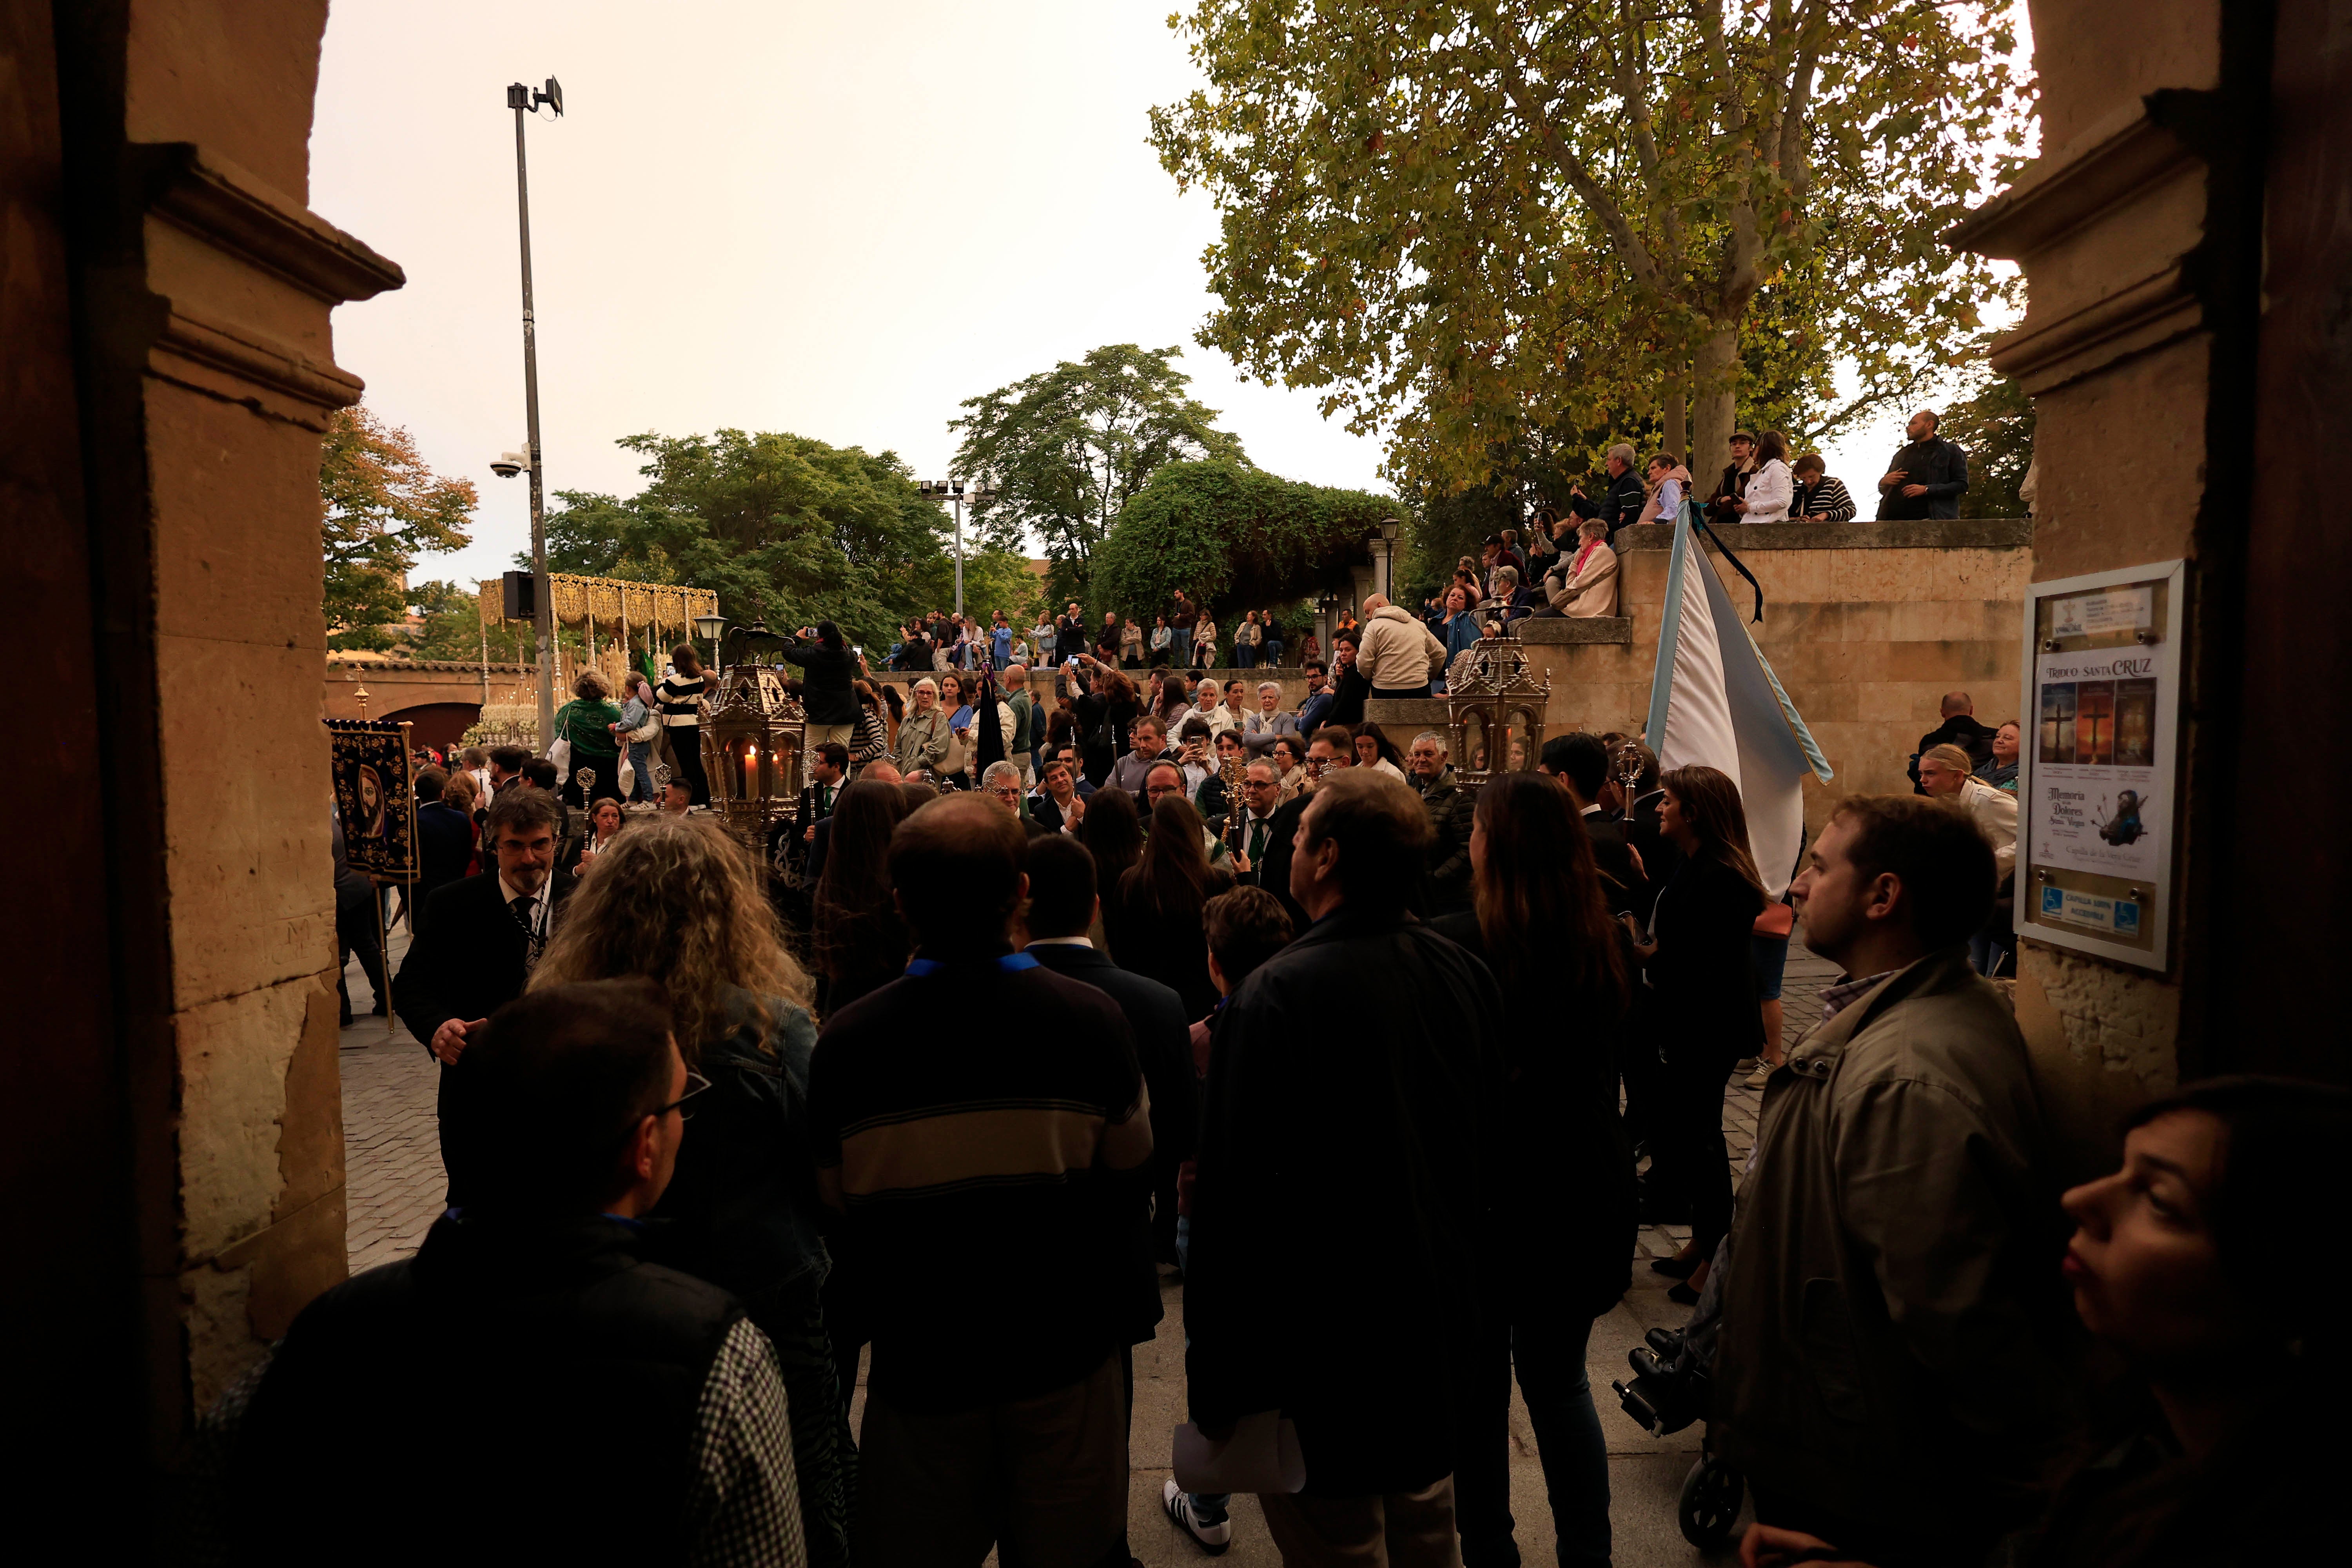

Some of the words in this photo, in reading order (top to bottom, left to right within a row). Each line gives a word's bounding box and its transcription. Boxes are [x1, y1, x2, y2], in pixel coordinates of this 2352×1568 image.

[2046, 668, 2078, 678] TRIDUO
[2083, 666, 2111, 677] SANTA
[2112, 659, 2151, 677] CRUZ
[2048, 788, 2085, 801] Memoria
[2053, 802, 2083, 816] Dolores
[2065, 894, 2091, 904] CAPILLA
